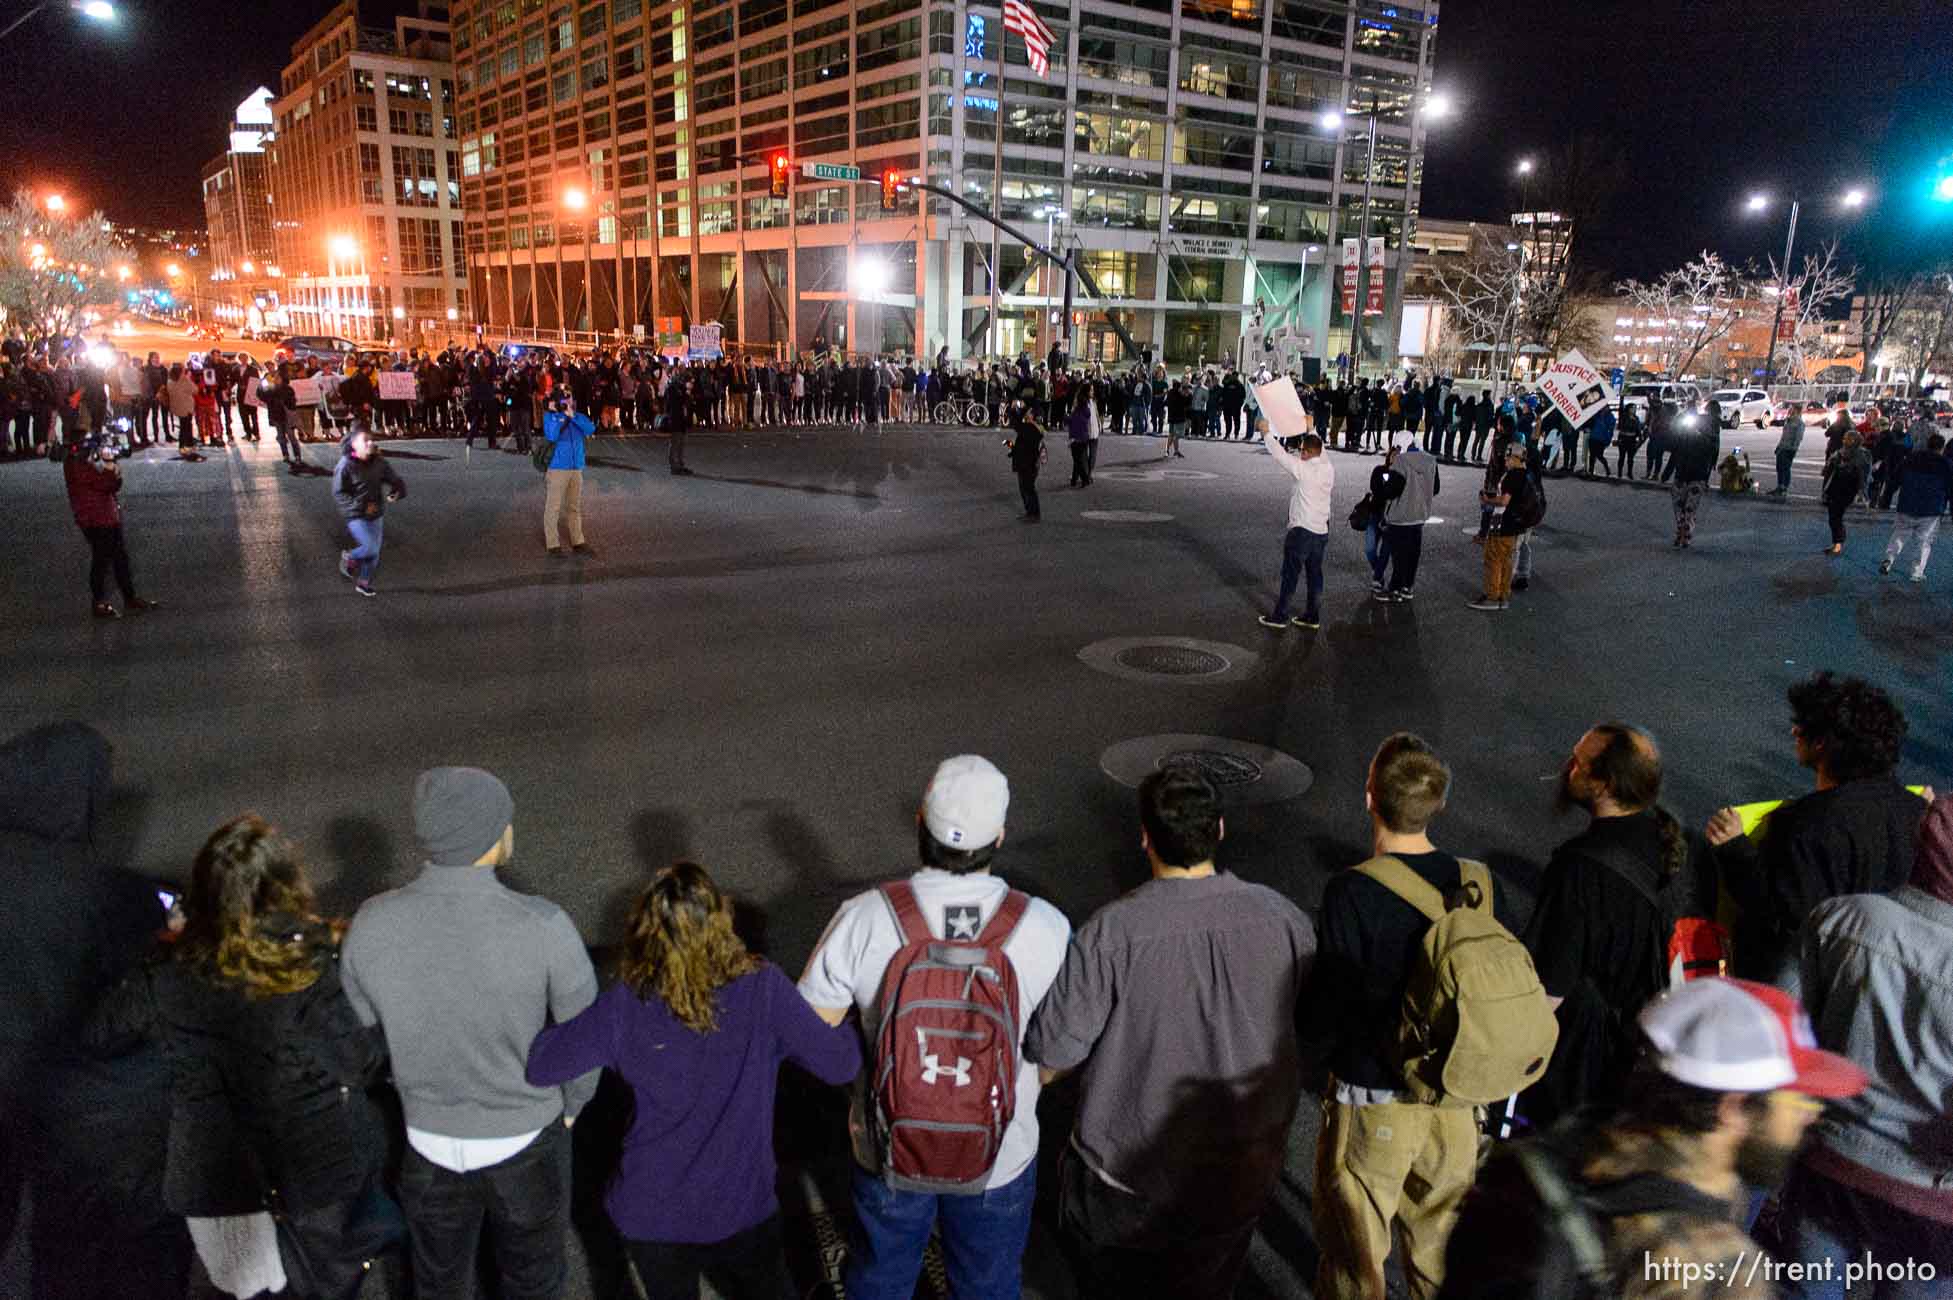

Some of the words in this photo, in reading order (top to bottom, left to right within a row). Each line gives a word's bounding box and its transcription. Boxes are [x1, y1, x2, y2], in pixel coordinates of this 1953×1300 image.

[818, 166, 842, 178] STATE
[1551, 362, 1598, 384] JUSTICE
[1567, 381, 1577, 390] 4
[1543, 379, 1582, 422] DARRIEN
